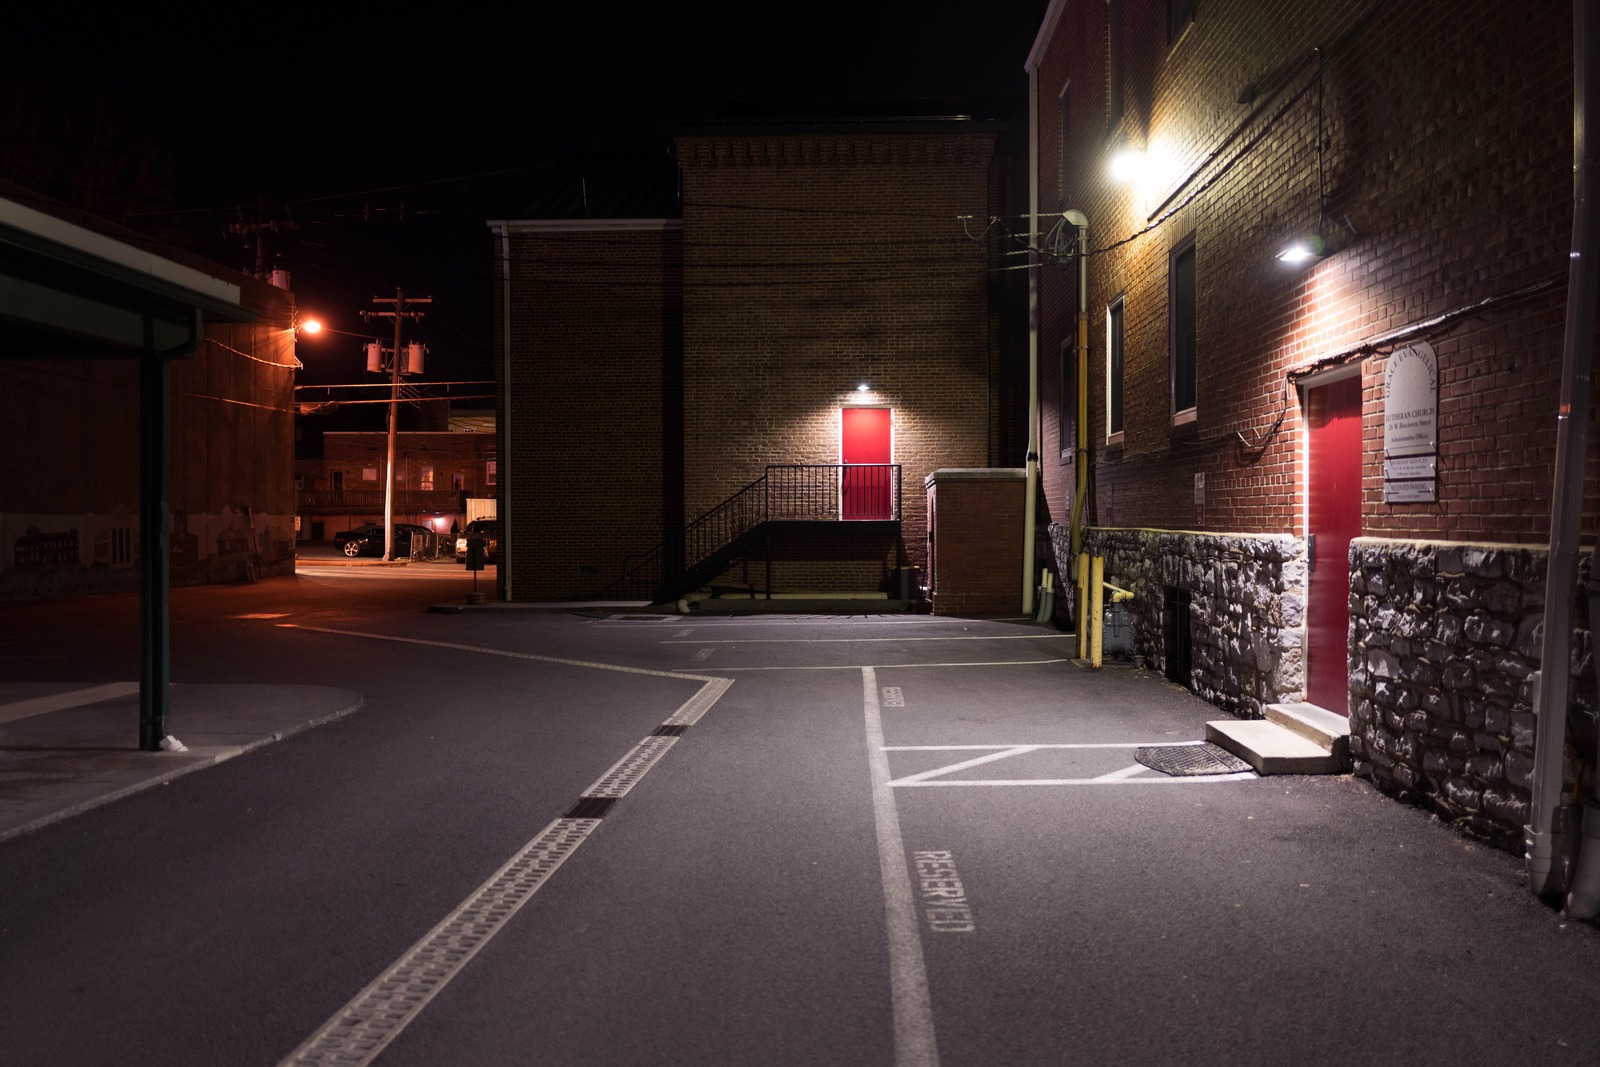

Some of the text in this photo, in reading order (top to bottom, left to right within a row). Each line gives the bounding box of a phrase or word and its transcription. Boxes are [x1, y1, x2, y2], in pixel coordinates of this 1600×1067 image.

[1386, 349, 1436, 398] GRACE EVANGELICAL
[1386, 407, 1435, 422] LUTHERAN CHURCH
[913, 850, 975, 932] RESERVED
